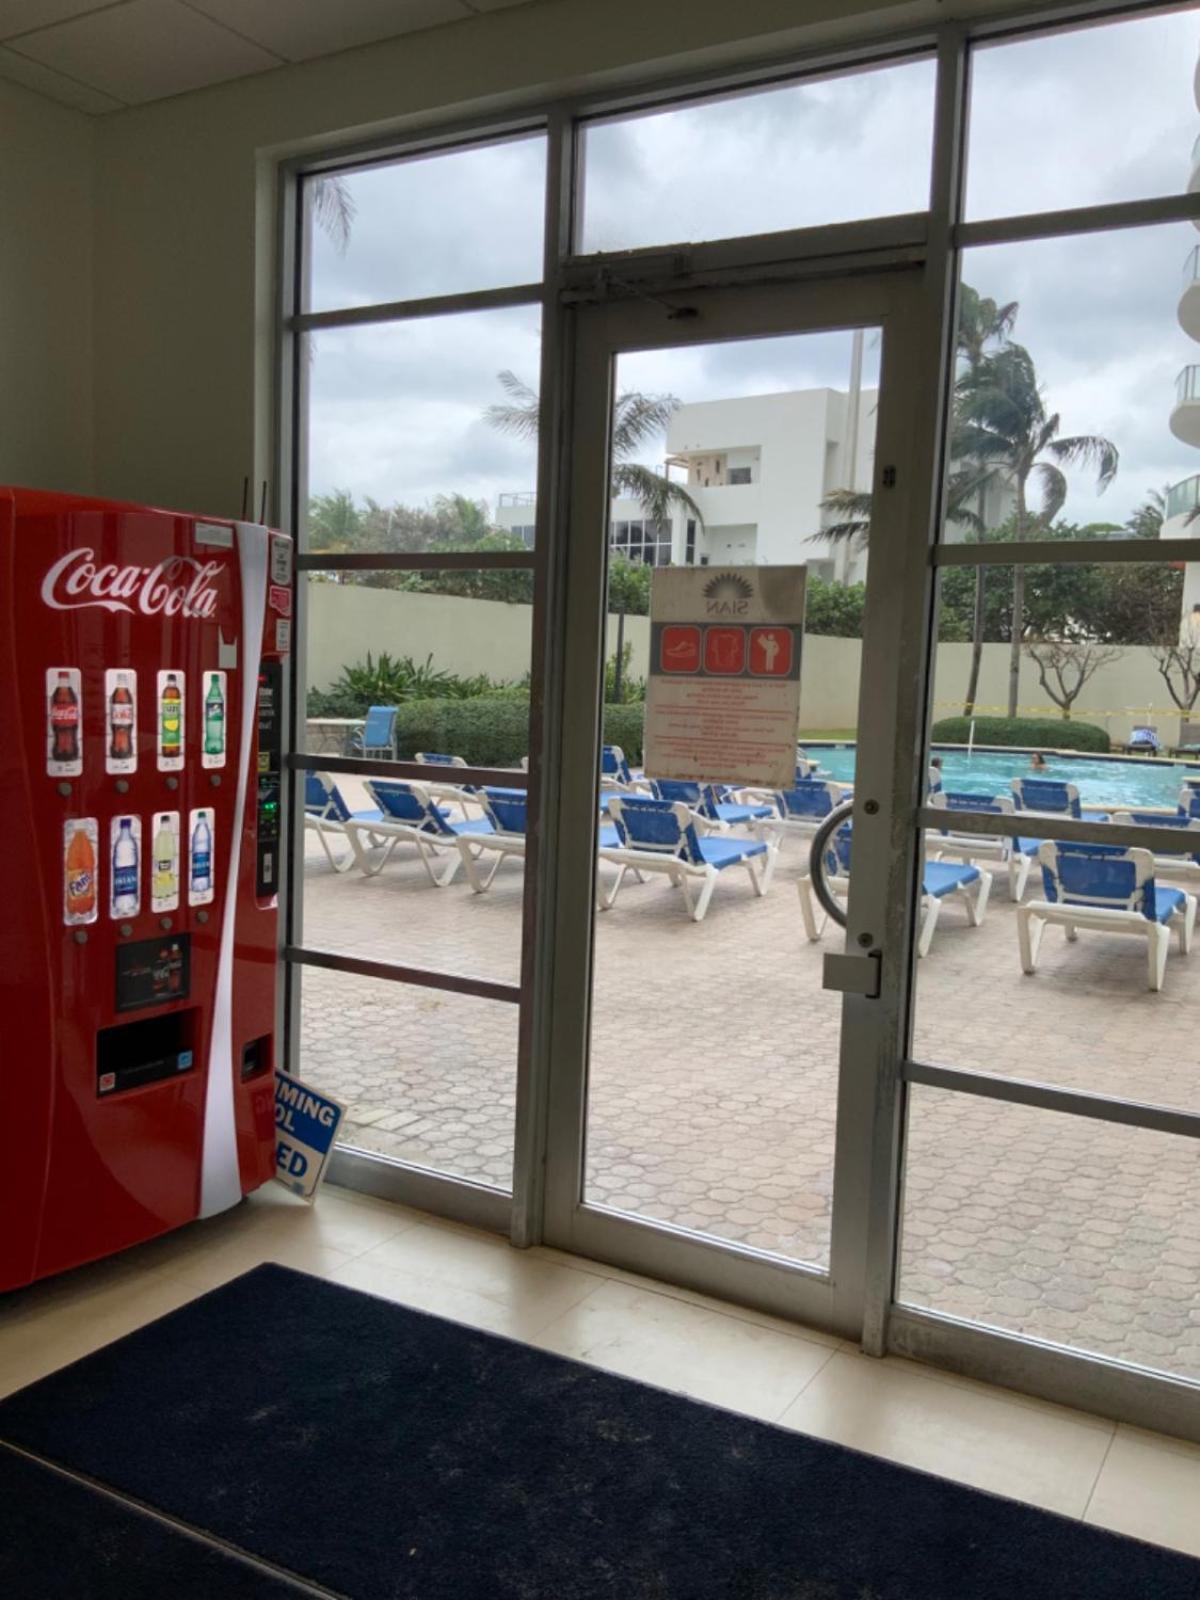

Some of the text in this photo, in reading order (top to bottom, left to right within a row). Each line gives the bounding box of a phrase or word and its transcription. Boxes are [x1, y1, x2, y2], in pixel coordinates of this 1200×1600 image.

[41, 547, 226, 618] Coca-Cola
[275, 1077, 336, 1128] MING
[276, 1141, 308, 1178] ED
